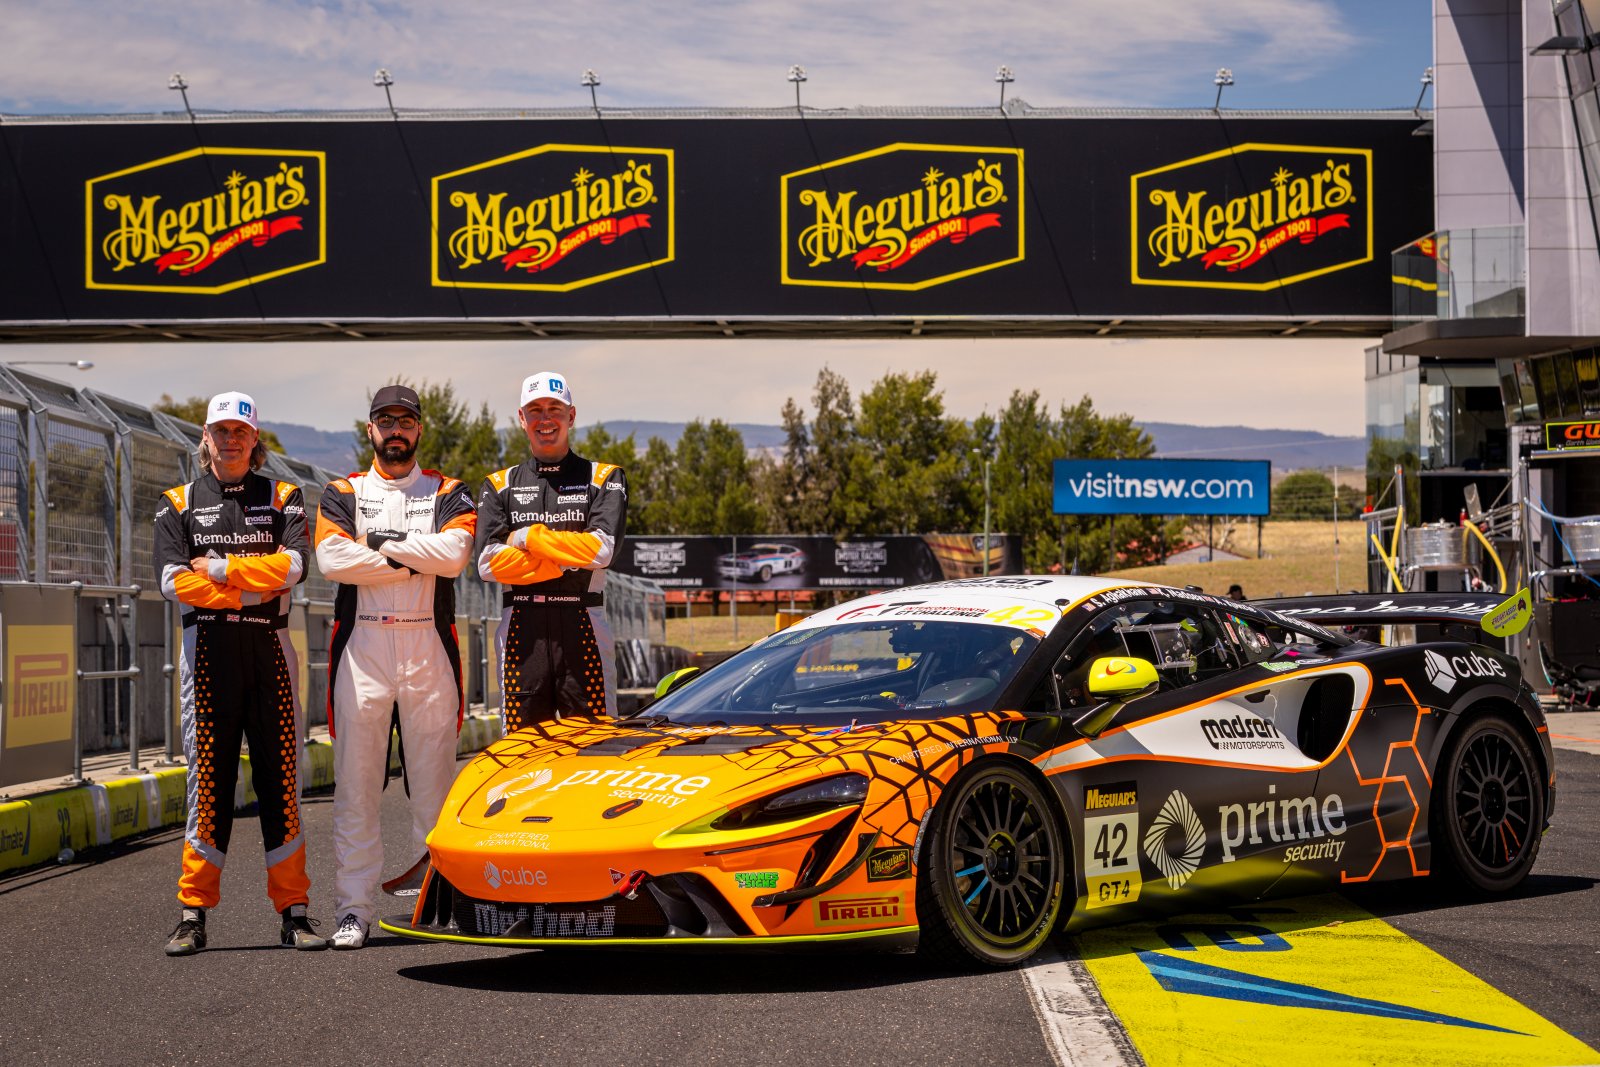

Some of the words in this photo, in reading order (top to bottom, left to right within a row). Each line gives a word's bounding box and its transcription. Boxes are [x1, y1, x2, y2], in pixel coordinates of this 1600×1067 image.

[102, 162, 306, 271] Meguiar's
[449, 159, 654, 269] Meguiar's
[799, 159, 1004, 268] Meguiar's
[1149, 159, 1354, 268] Meguiar's
[212, 232, 239, 258] Since
[240, 222, 264, 238] 1901
[559, 230, 587, 255] Since
[587, 219, 612, 237] 1901
[909, 230, 937, 255] Since
[937, 219, 962, 236] 1901
[1259, 230, 1286, 255] Since
[1286, 219, 1311, 236] 1901
[1069, 472, 1253, 498] visitnsw.com
[193, 531, 273, 546] Remo.health
[984, 605, 1055, 629] 42
[1452, 651, 1506, 678] cube
[13, 653, 69, 718] PIRELLI
[1200, 715, 1279, 750] madsen
[1229, 740, 1285, 750] MOTORSPORTS
[889, 744, 943, 765] CHARTERED
[944, 736, 1004, 750] INTERNATIONAL
[546, 765, 711, 796] prime
[609, 788, 687, 809] security
[1085, 789, 1137, 811] MEGUIAR'S
[489, 832, 550, 841] CHARTERED
[1219, 784, 1348, 863] prime
[475, 839, 551, 850] INTERNATIONAL
[1093, 822, 1129, 868] 42
[1283, 838, 1346, 863] security
[501, 866, 548, 886] cube
[872, 851, 907, 874] Meguiar's
[745, 880, 777, 888] SIGNS
[1099, 881, 1131, 901] GT4
[819, 896, 899, 921] PIRELLI
